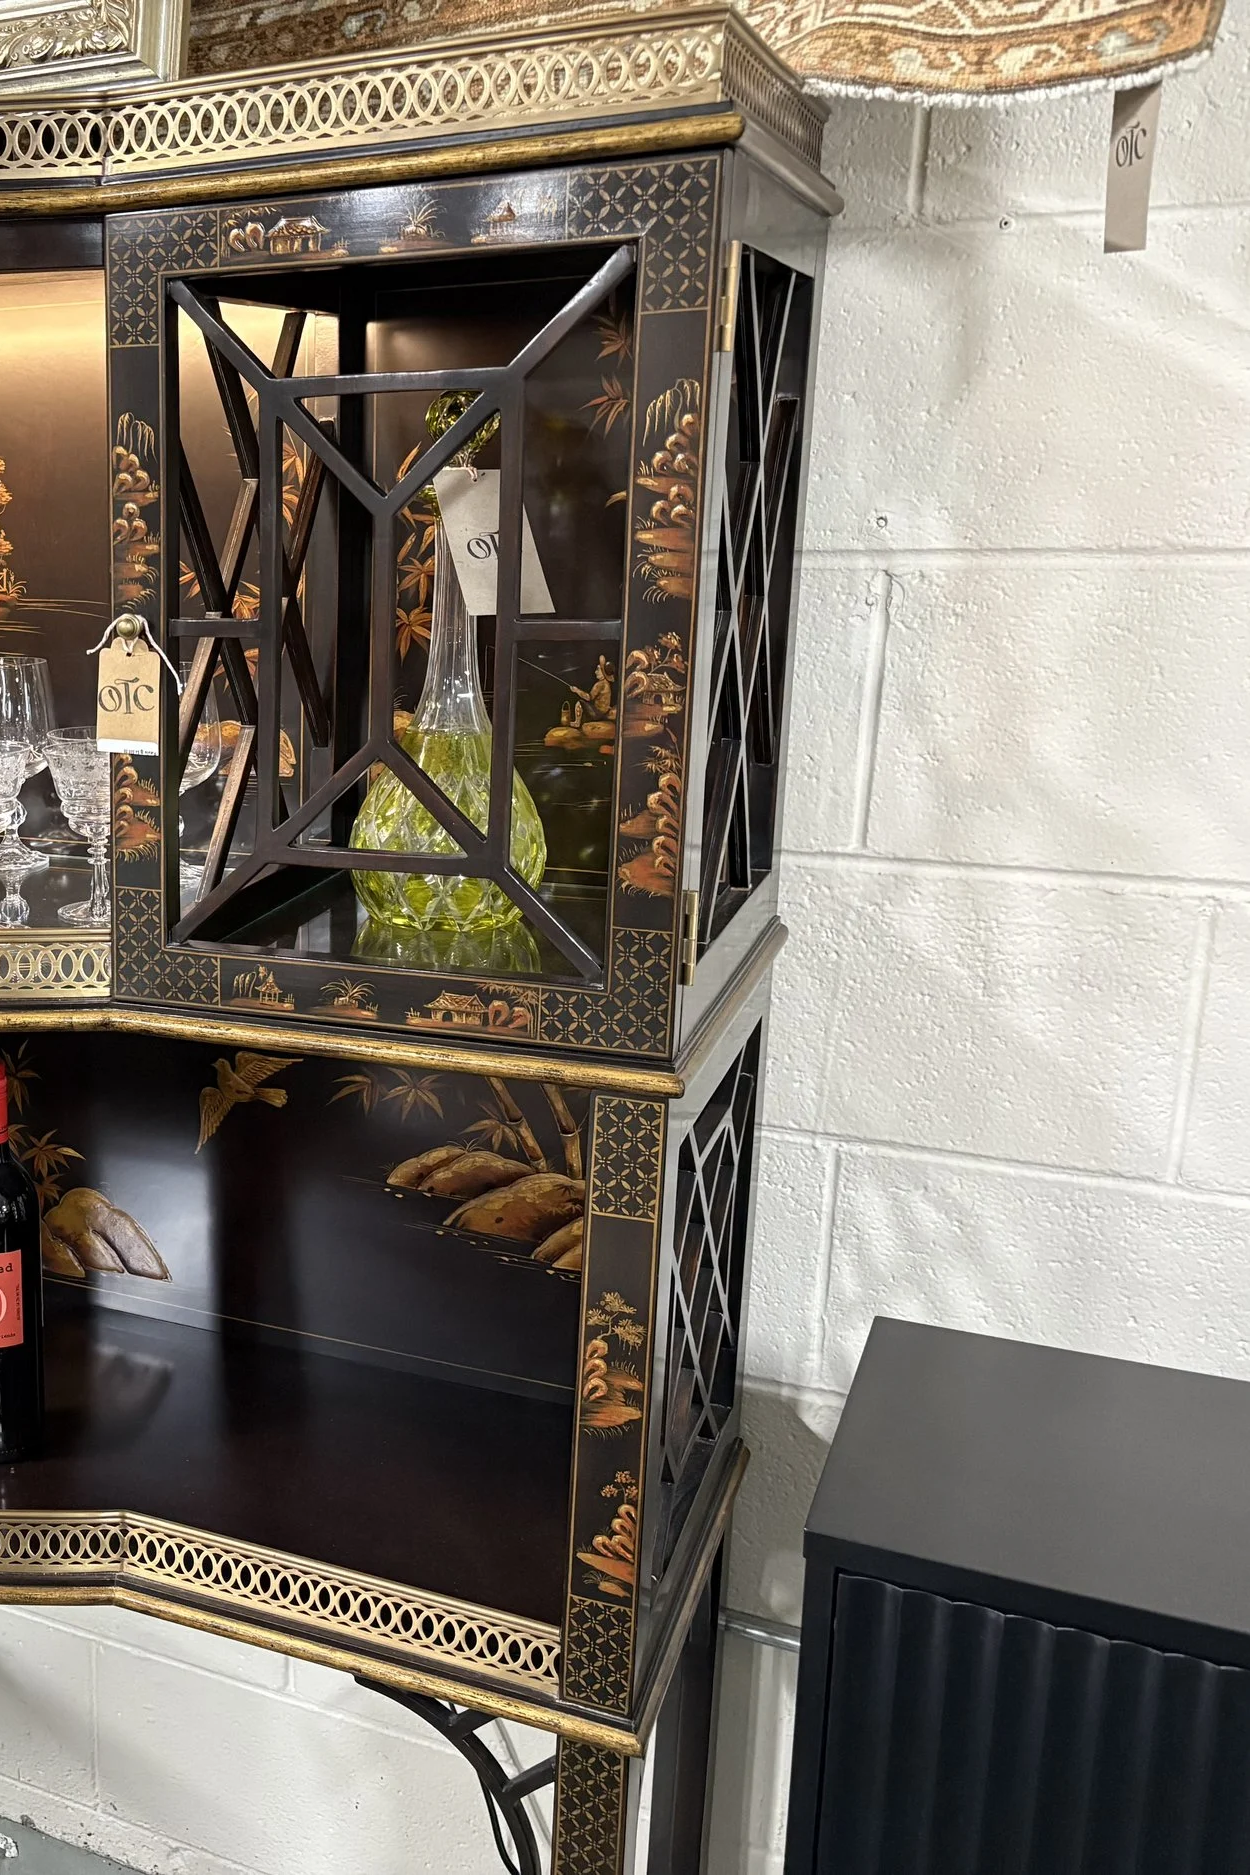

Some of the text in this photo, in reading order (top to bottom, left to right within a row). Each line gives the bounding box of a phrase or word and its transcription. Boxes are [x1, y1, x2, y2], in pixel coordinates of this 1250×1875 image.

[1116, 121, 1147, 167] OTC
[466, 531, 499, 560] OT
[99, 677, 155, 715] OTC
